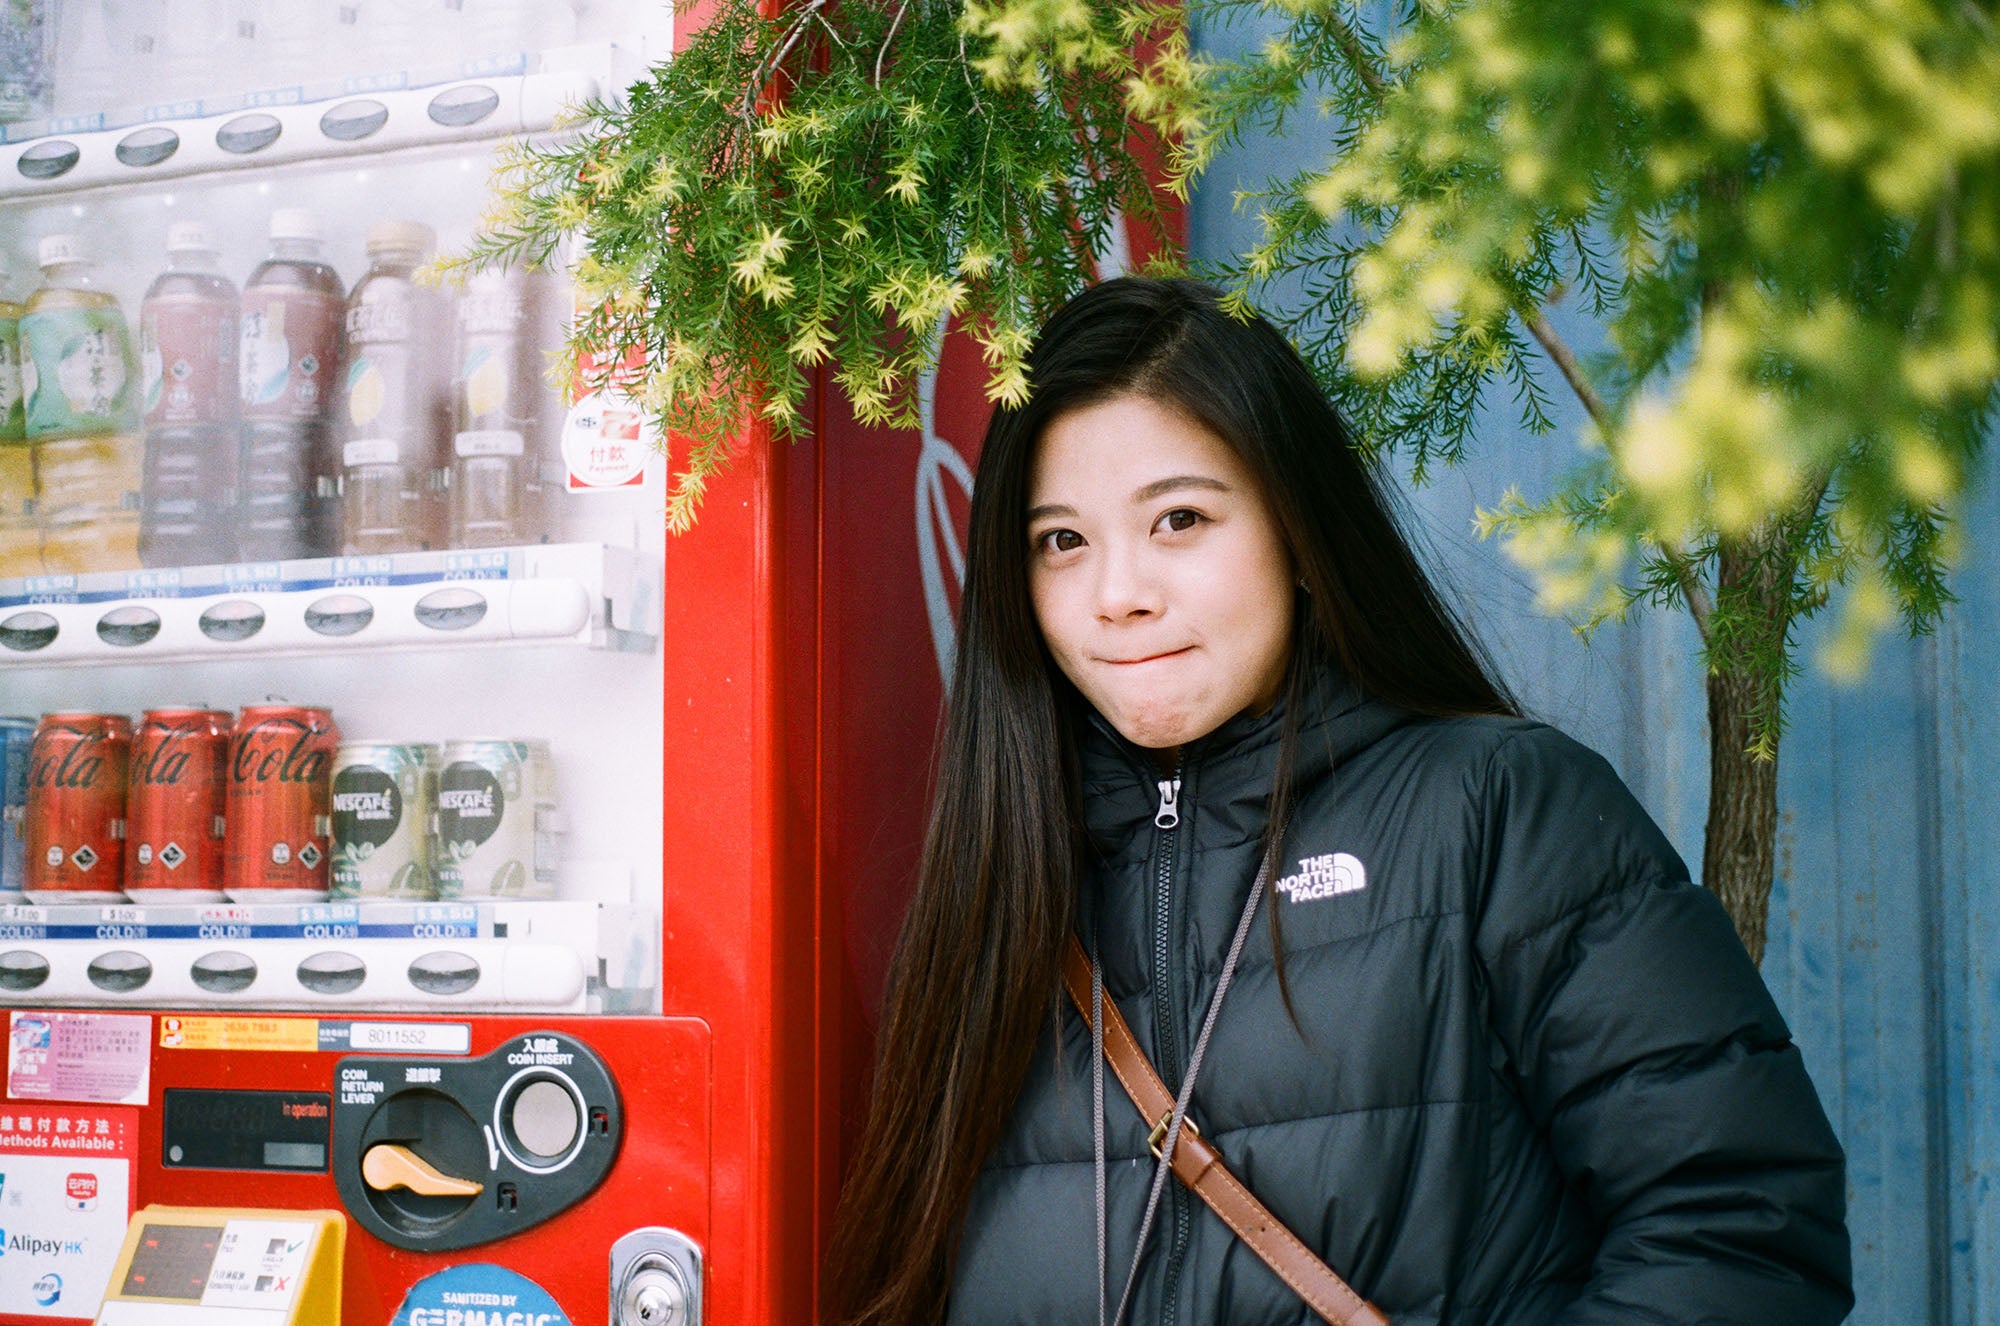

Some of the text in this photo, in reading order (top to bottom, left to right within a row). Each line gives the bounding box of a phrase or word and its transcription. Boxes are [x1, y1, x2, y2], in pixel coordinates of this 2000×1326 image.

[590, 446, 625, 463] 付款
[232, 718, 332, 784] Cola
[1298, 854, 1334, 873] THE
[1275, 867, 1334, 893] NORTH
[1291, 882, 1335, 903] FACE
[368, 1028, 426, 1044] 8011552
[507, 1053, 574, 1065] COIN INSERT
[341, 1069, 368, 1080] COIN
[341, 1081, 384, 1092] RETURN
[341, 1093, 375, 1104] LEVER
[292, 1101, 328, 1120] operation
[9, 1234, 83, 1256] Alipay HK
[442, 1292, 517, 1307] SANITIZED BY
